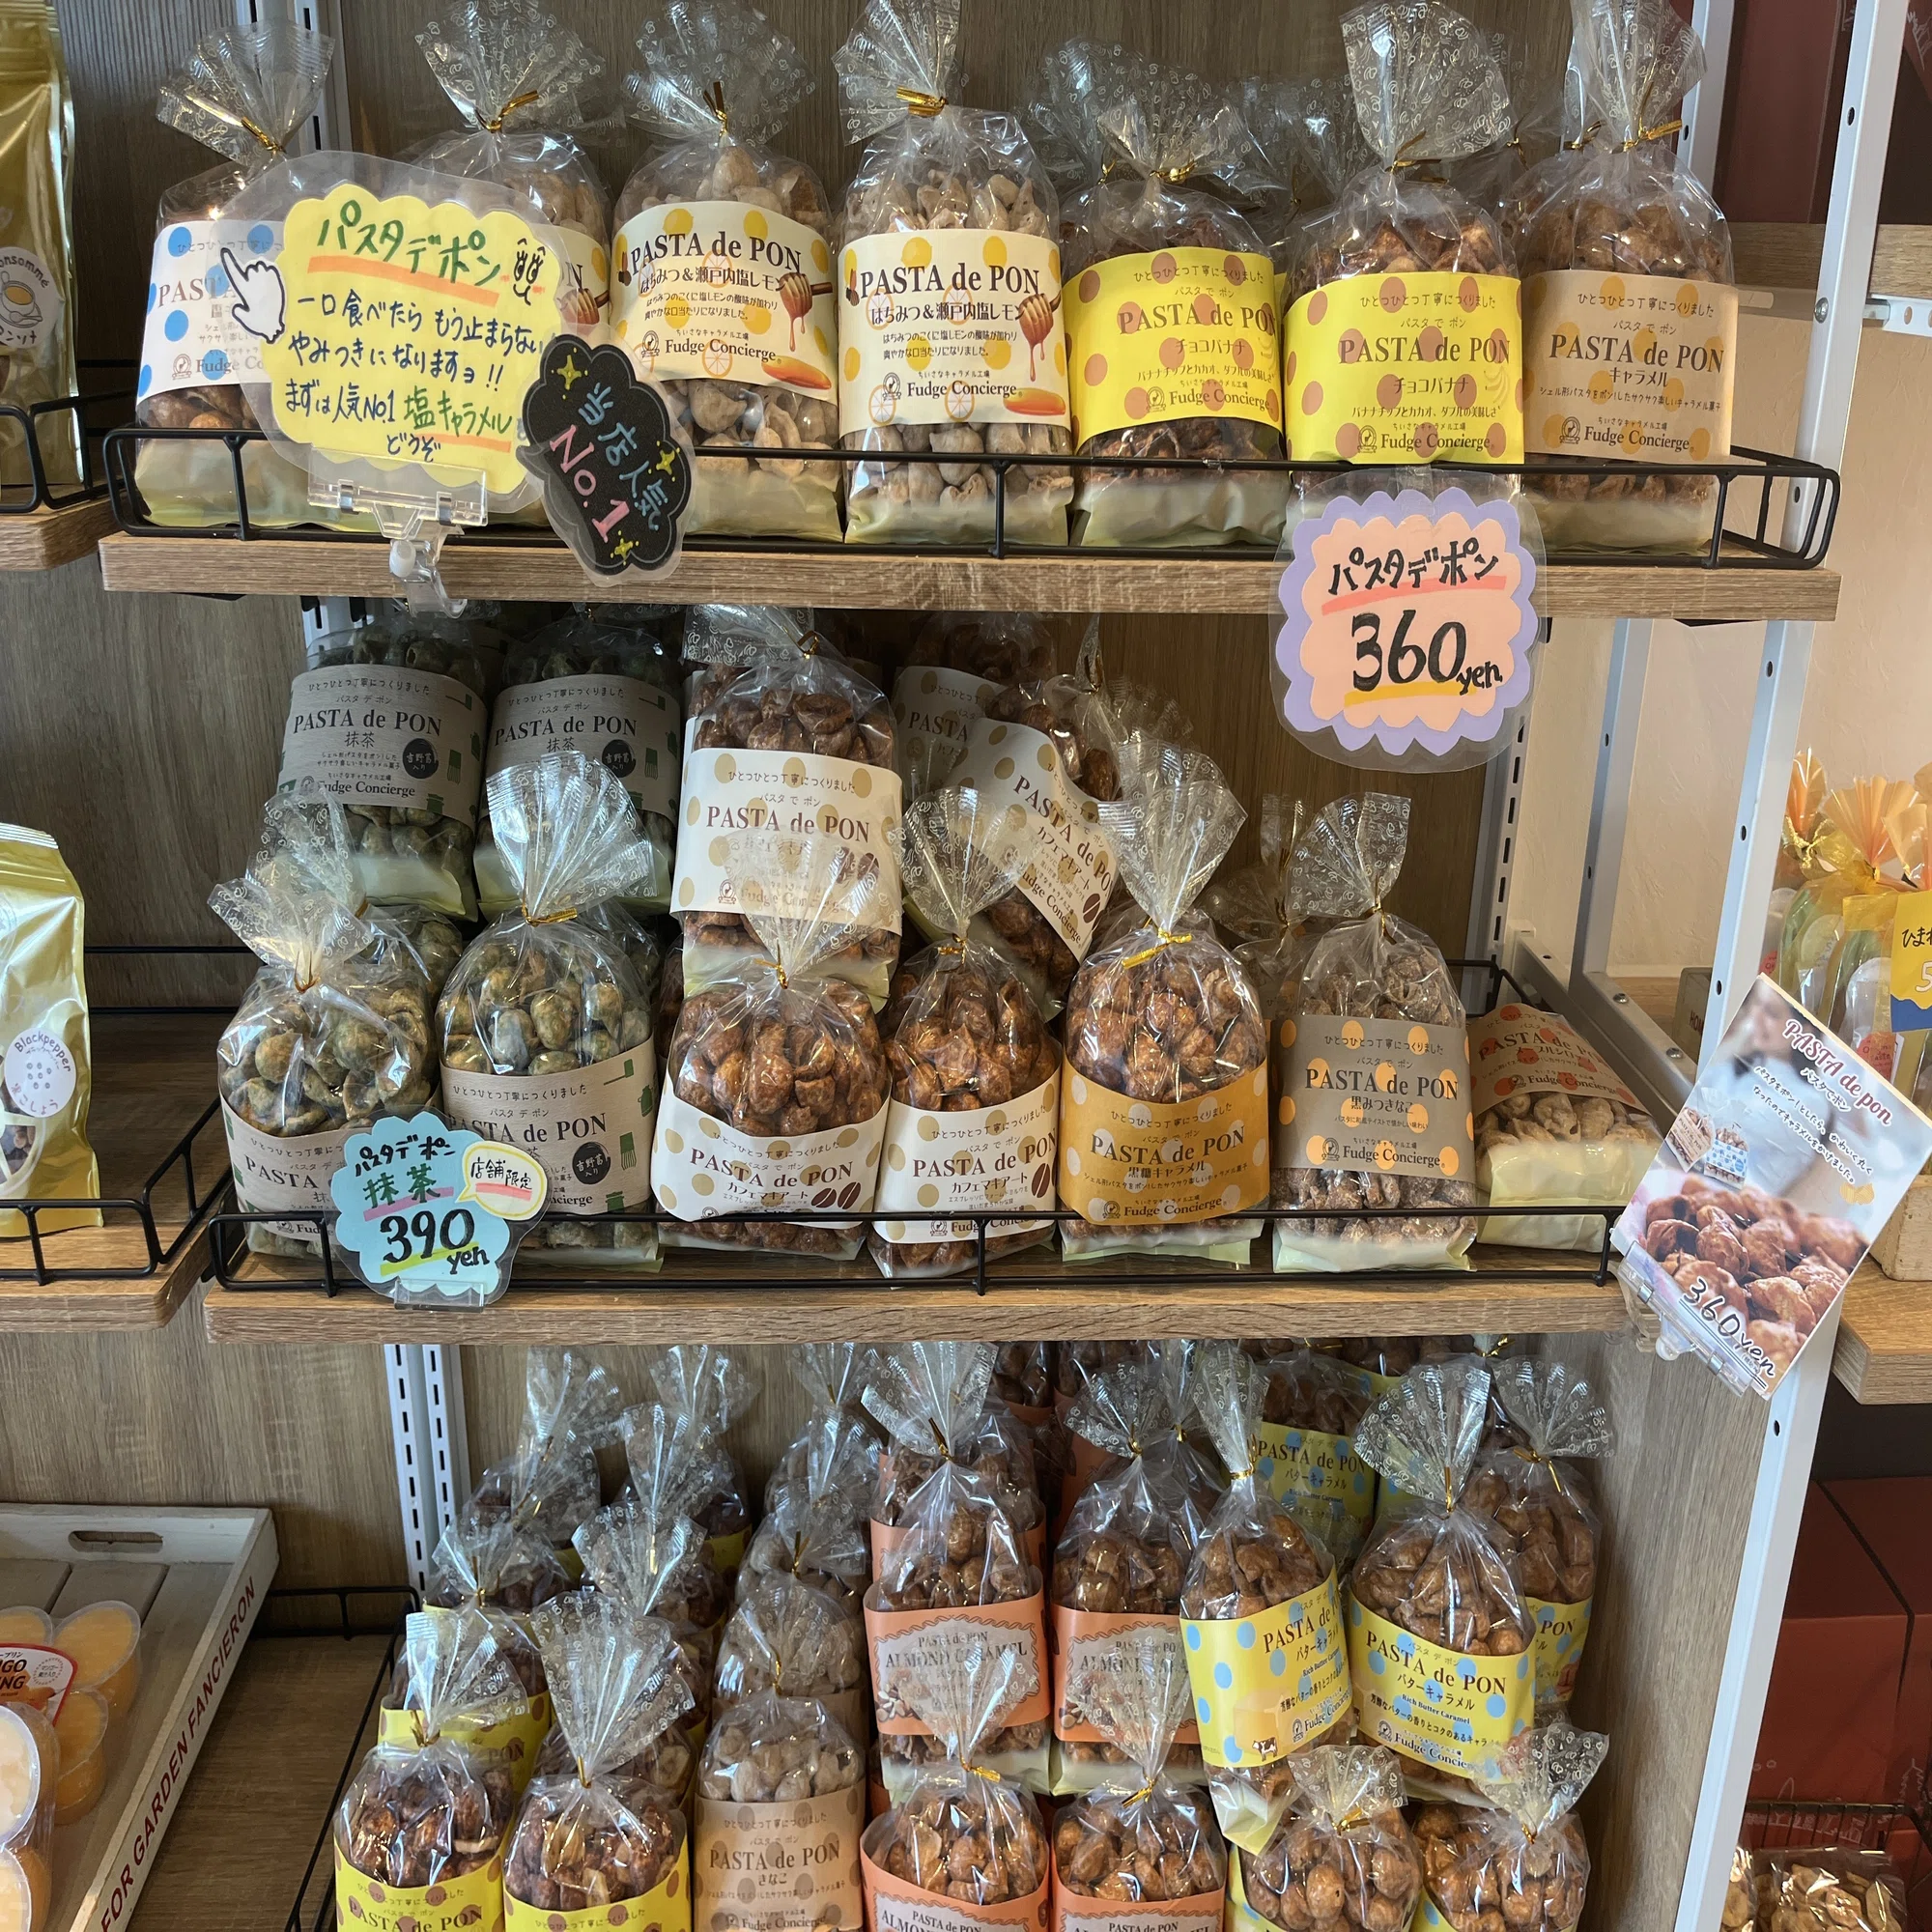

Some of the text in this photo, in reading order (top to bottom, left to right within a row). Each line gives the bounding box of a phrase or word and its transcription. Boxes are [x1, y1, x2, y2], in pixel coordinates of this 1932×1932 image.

[317, 200, 500, 286] パスタデポン
[630, 231, 802, 275] PASTA de PON
[861, 263, 1039, 299] PASTA de PON
[1360, 293, 1496, 309] ひとつひとつ丁寧につくりました
[1577, 293, 1714, 318] ひとつひとつ丁寧につくりました
[1119, 303, 1276, 336] PASTA de PON
[665, 338, 777, 362] Fudge Concierge
[1175, 339, 1246, 355] チョコバナナ
[1339, 336, 1511, 364] PASTA de PON
[1549, 334, 1724, 373] PASTA de PON
[196, 358, 239, 374] Fudge
[1608, 367, 1668, 387] キャラメル
[907, 381, 1017, 399] Fudge Concierge
[1170, 389, 1269, 411] Fudge Concierge
[1393, 378, 1469, 394] チョコバナナ
[386, 434, 440, 462] どうぞ
[1380, 434, 1491, 451] Fudge Concierge
[1584, 426, 1690, 452] Fudge Concierge
[578, 383, 668, 531] 当店人気
[550, 424, 630, 543] No.1
[1328, 537, 1499, 595] パスタデポン
[1351, 609, 1503, 696] 360 yen
[293, 708, 442, 736] PASTA de PON
[495, 716, 638, 746] PASTA de PON
[908, 712, 968, 742] PASTA
[345, 730, 375, 748] 抹茶
[547, 736, 576, 753] 抹茶
[355, 781, 415, 798] Concierge
[706, 806, 870, 843] PASTA de PON
[1013, 775, 1072, 843] PASTA
[1077, 841, 1094, 867] de
[1046, 894, 1081, 944] Concierge
[1325, 1036, 1444, 1056] ひとつひとつ丁寧につくりました
[1478, 1033, 1545, 1061] PASTA
[1305, 1068, 1458, 1101] PASTA de PON
[1528, 1075, 1561, 1085] Fudge
[1783, 1020, 1844, 1076] PASTA
[1839, 1075, 1862, 1096] de
[1856, 1094, 1892, 1124] pon
[453, 1084, 587, 1101] ひとつひとつ丁寧につくりました
[1350, 1095, 1414, 1115] 黒みつきなこ
[524, 1113, 608, 1142] de PON
[913, 1129, 1056, 1178] PASTA de PON
[1091, 1125, 1244, 1165] PASTA de PON
[1343, 1146, 1440, 1168] Fudge Concierge
[244, 1154, 319, 1189] PASTA
[690, 1148, 853, 1187] PASTA de PON
[363, 1163, 440, 1208] 抹茶
[952, 1173, 1028, 1193] カフェマキアート
[1124, 1198, 1222, 1217] Fudge Concierge
[380, 1208, 490, 1275] 390 yen
[1684, 1278, 1741, 1336] 360
[1256, 1440, 1334, 1468] PASTA de
[1264, 1607, 1330, 1654] PASTA de
[1540, 1618, 1576, 1635] PON
[0, 1660, 27, 1672] GO
[1366, 1631, 1507, 1694] PASTA de PON
[1397, 1673, 1475, 1710] バターキャラメル
[101, 1577, 255, 1932] FOR GARDEN FANCIERON
[1395, 1733, 1426, 1754] Fudge
[709, 1841, 839, 1870] PASTA de PON
[440, 1906, 482, 1930] PON
[912, 1911, 943, 1929] PASTA
